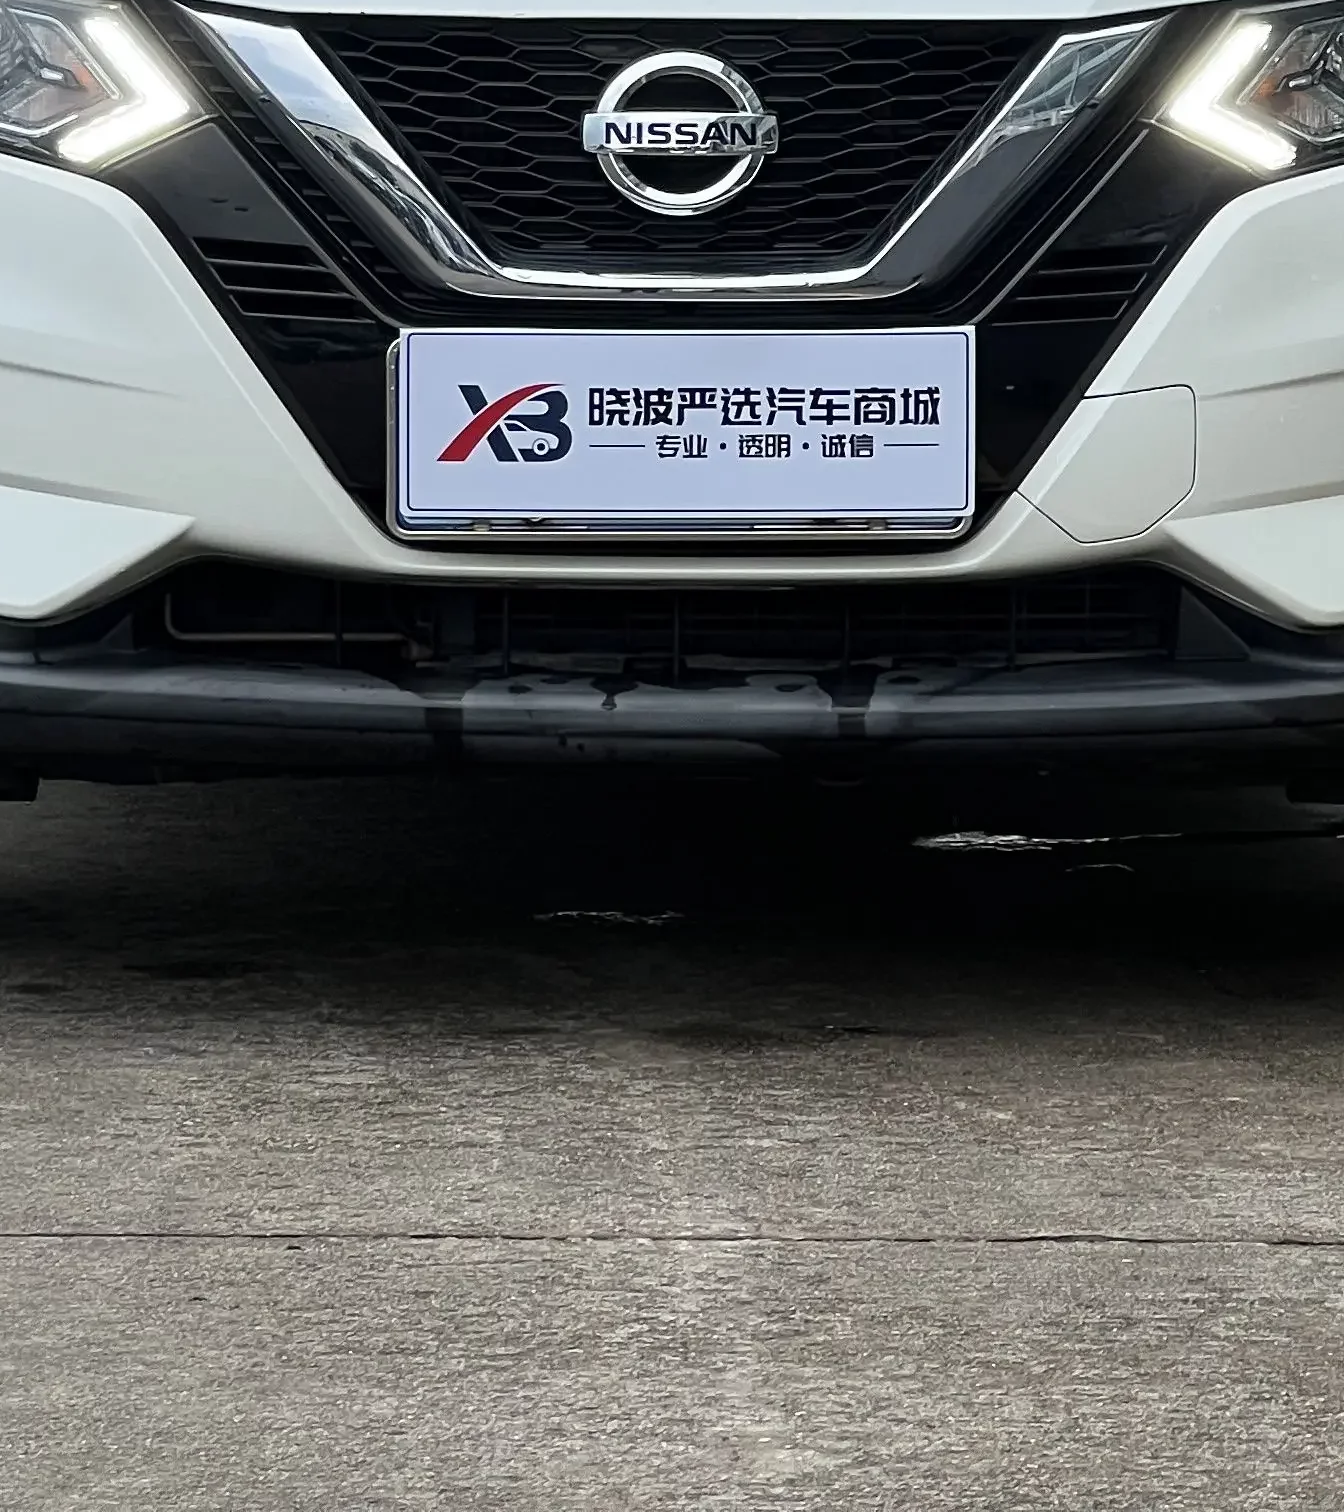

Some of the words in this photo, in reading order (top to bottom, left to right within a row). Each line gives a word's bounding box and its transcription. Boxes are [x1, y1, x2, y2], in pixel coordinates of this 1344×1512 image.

[604, 122, 757, 146] NISSAN
[589, 387, 940, 426] 晓波严选汽车商城
